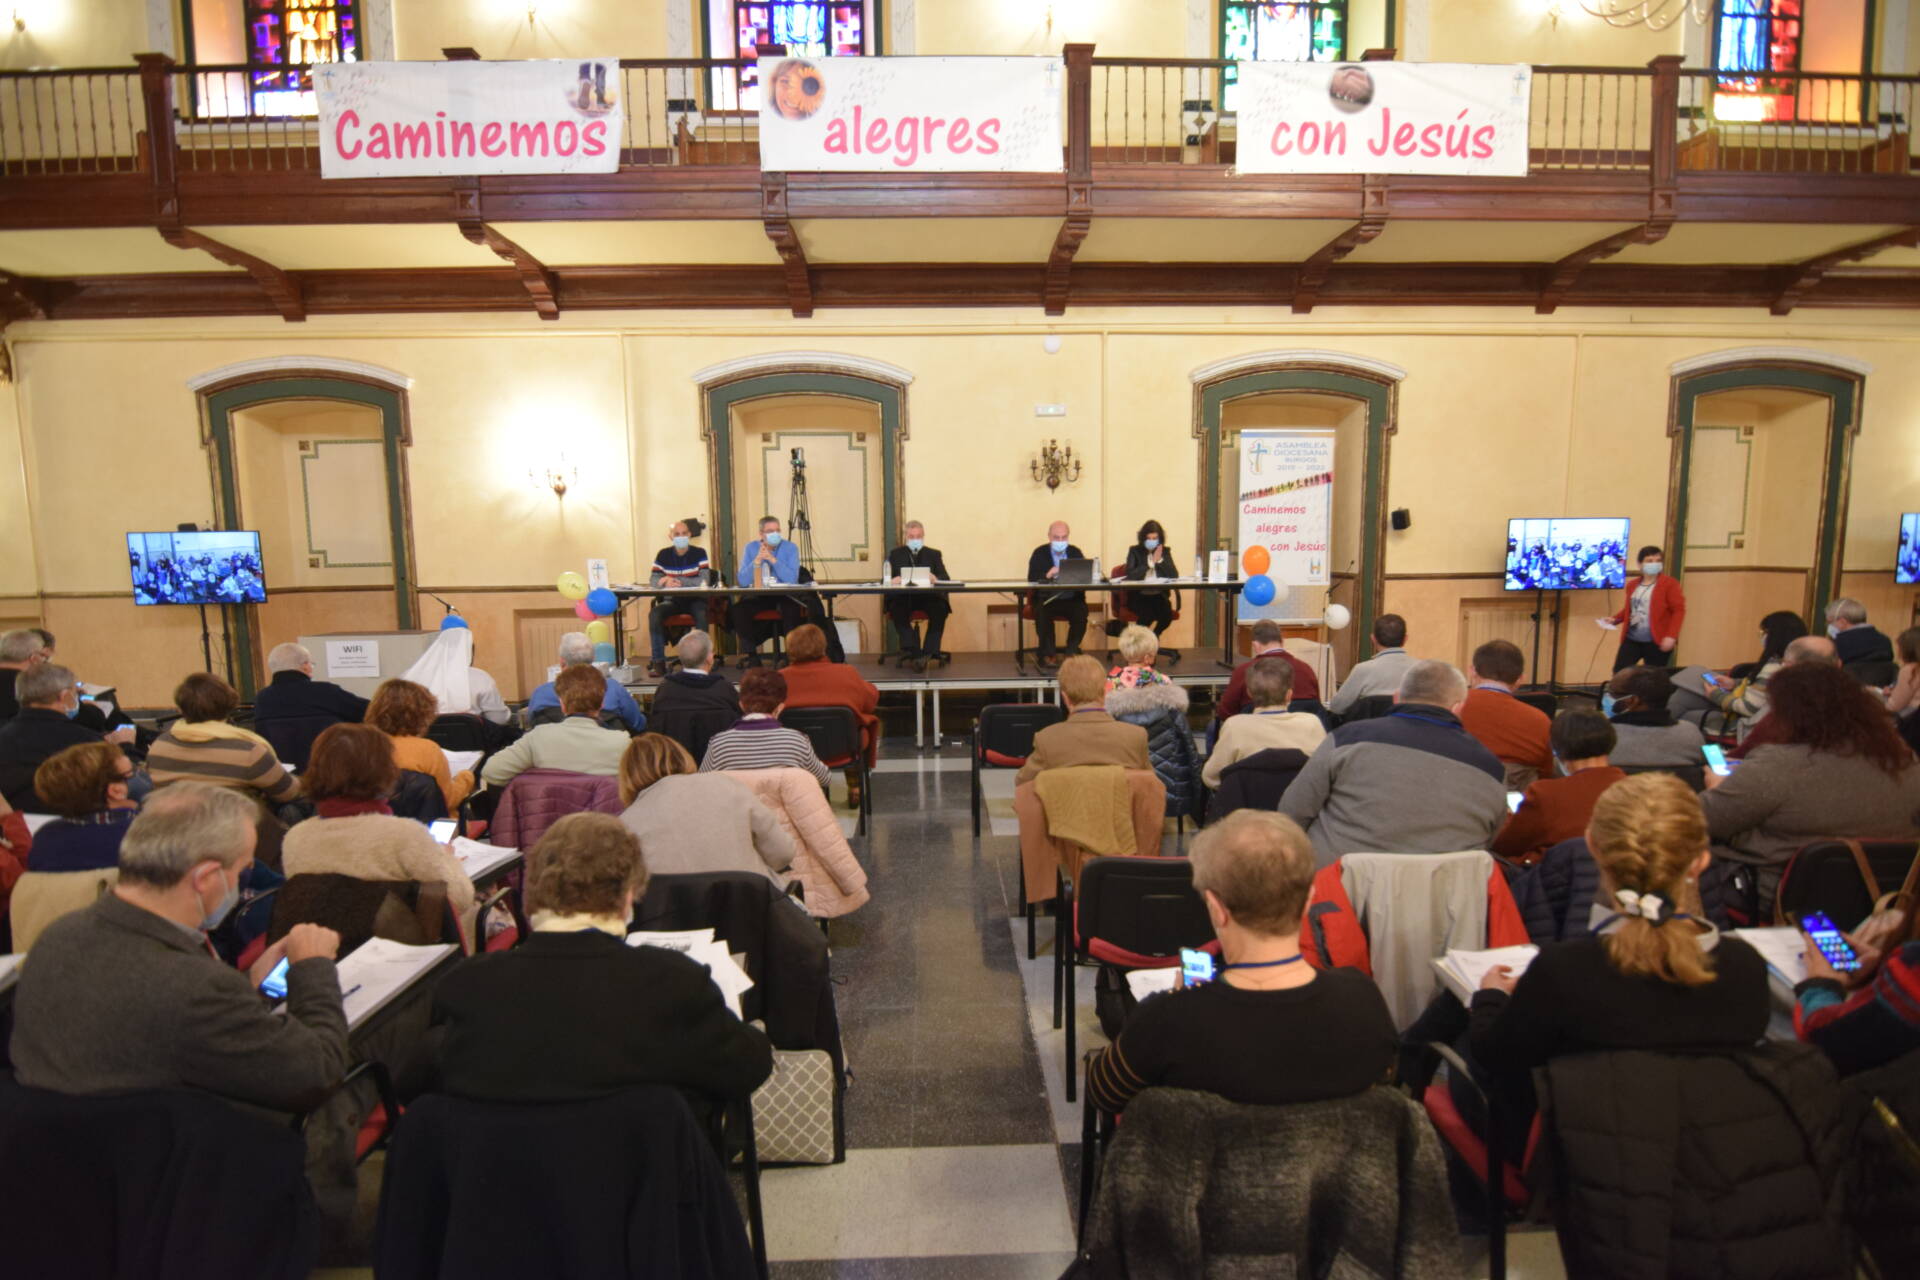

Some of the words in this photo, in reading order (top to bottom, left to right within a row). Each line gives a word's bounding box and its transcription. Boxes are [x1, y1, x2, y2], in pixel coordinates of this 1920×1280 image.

[336, 109, 607, 160] Caminemos
[823, 105, 1000, 167] alegres
[1270, 120, 1347, 156] con
[1367, 107, 1495, 159] Jesús
[1243, 504, 1306, 514] Caminemos
[1255, 523, 1297, 535] alegres
[1270, 543, 1290, 551] con
[1294, 541, 1326, 551] Jesús
